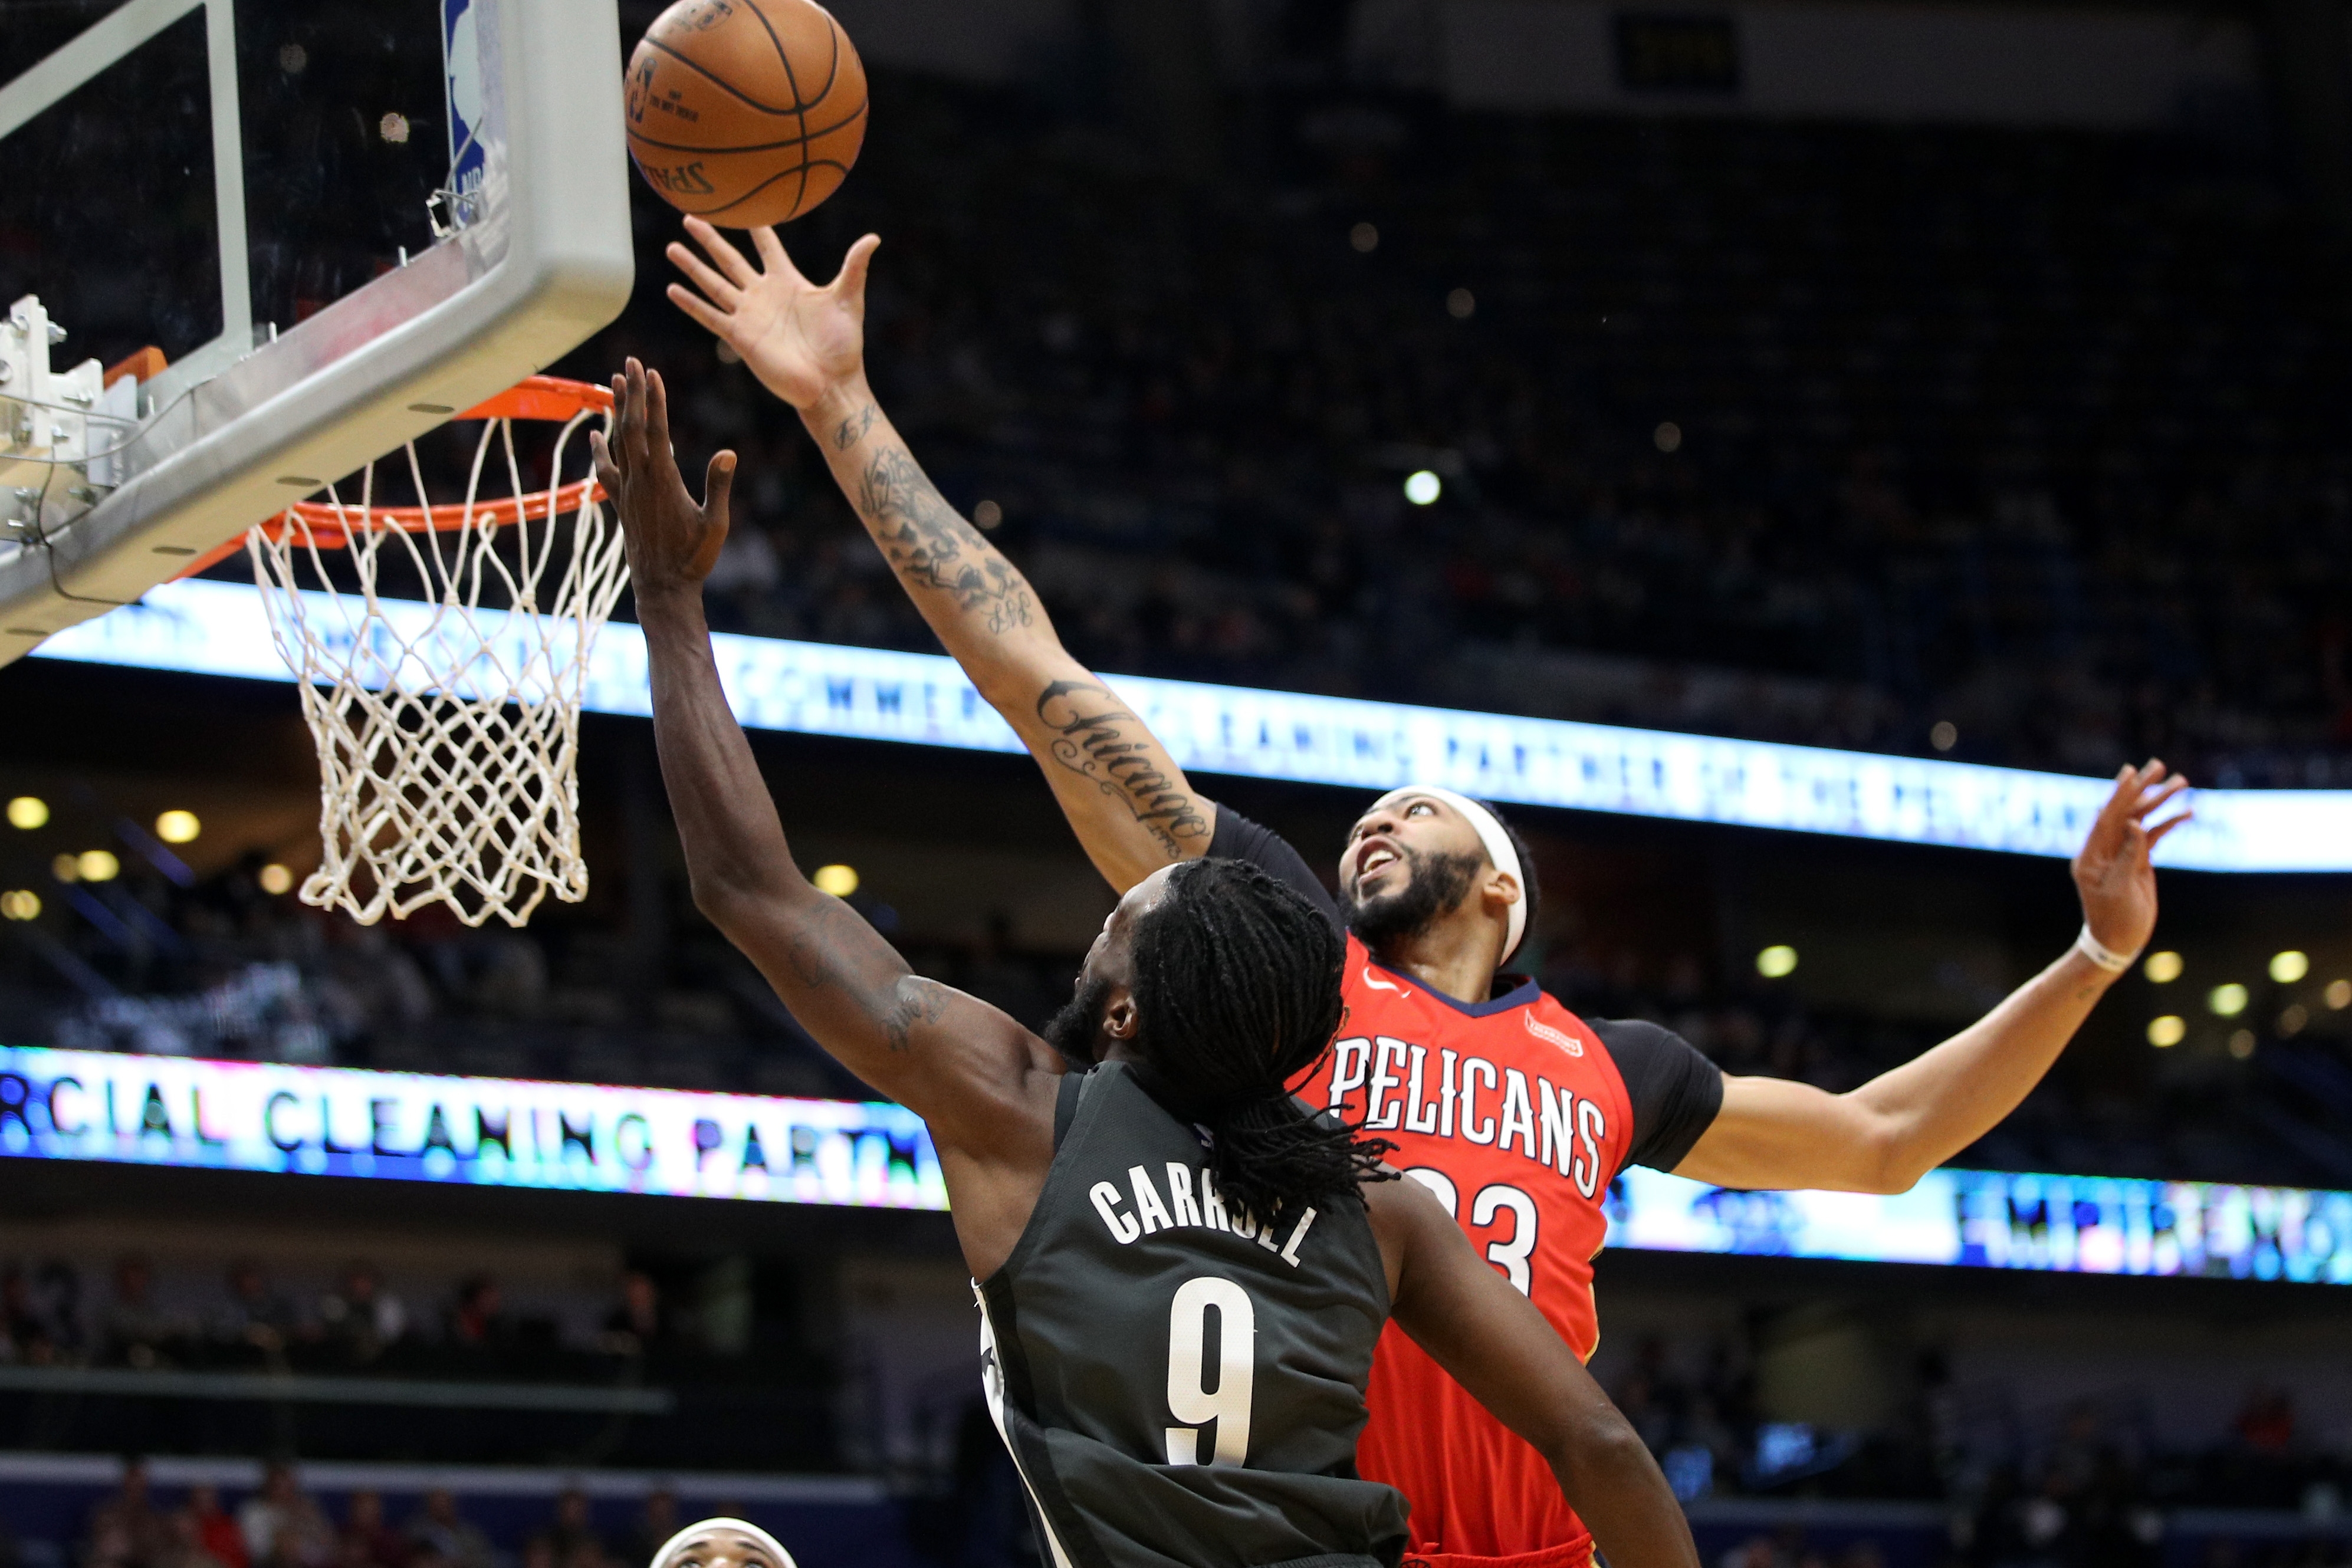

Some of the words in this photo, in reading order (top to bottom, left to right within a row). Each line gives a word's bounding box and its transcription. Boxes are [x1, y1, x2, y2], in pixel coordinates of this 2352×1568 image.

[265, 1090, 653, 1171] CLEANING
[695, 1117, 918, 1179] PARTN
[1329, 1036, 1606, 1199] PELICANS
[1165, 1276, 1255, 1469] 9
